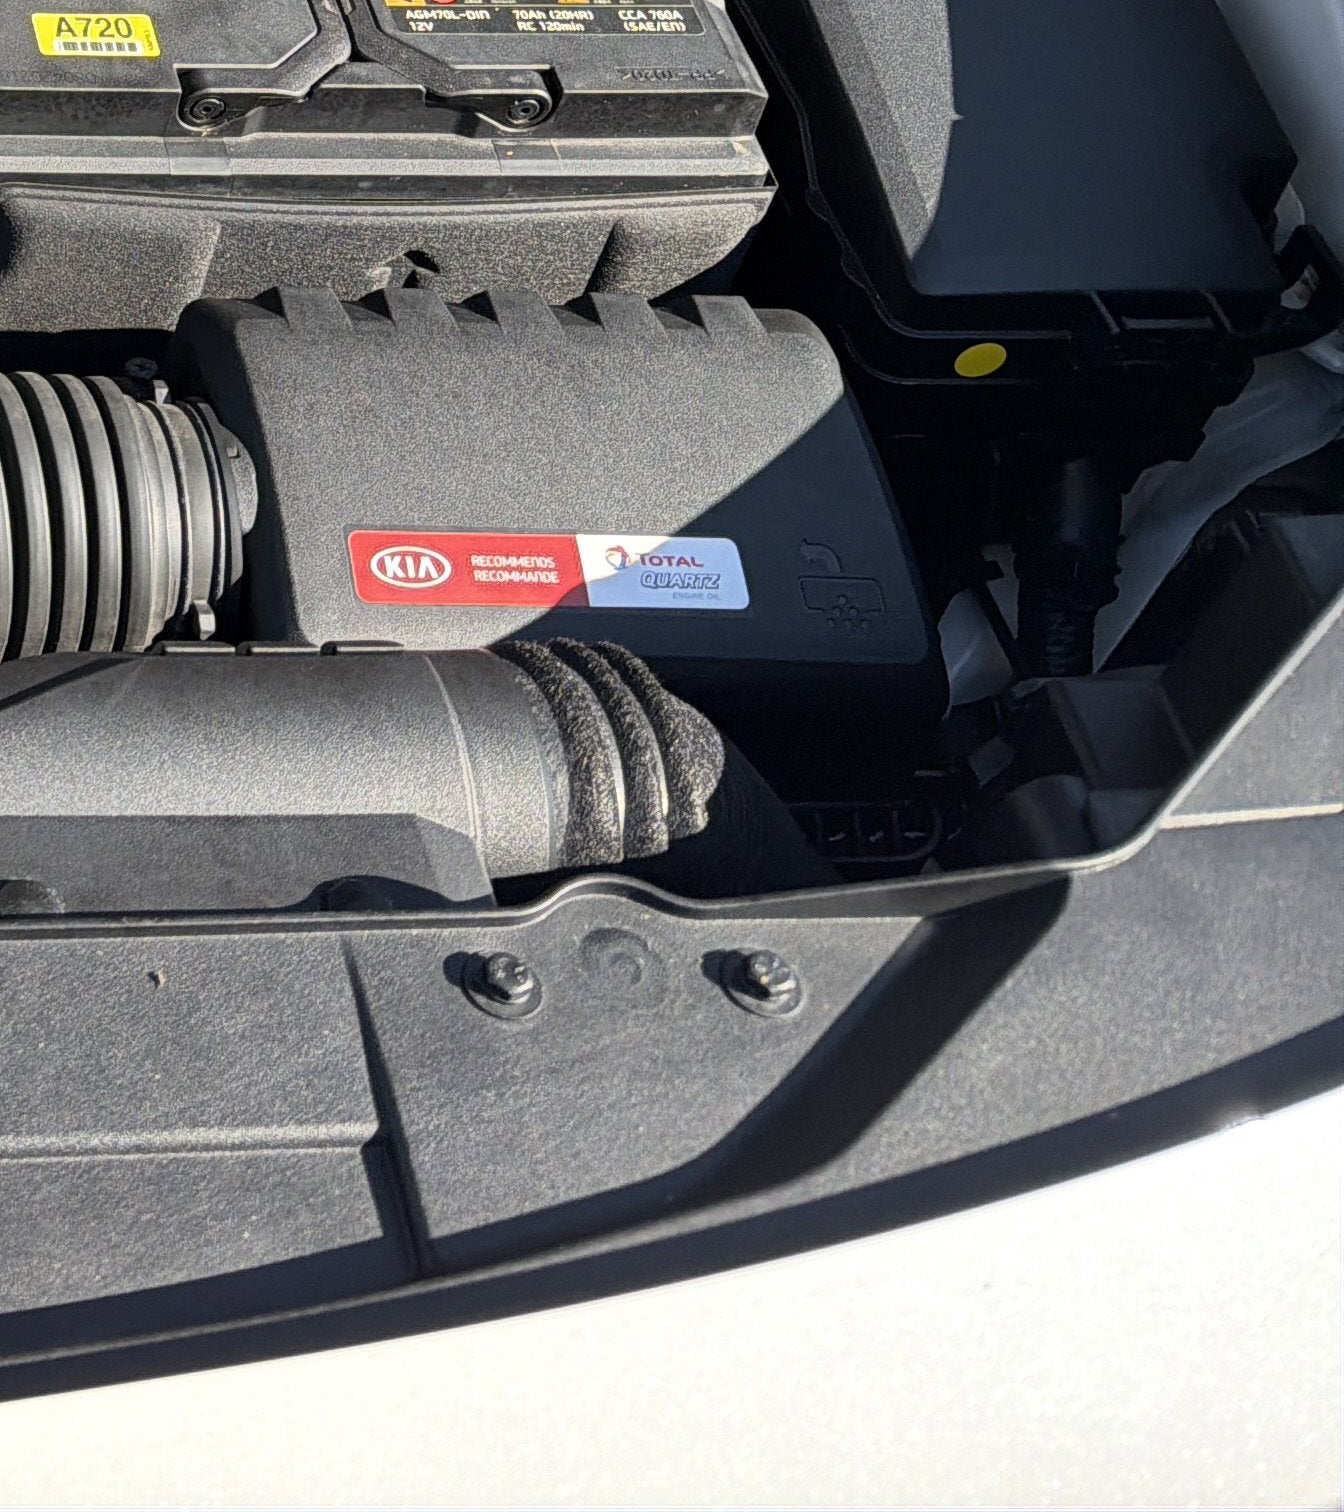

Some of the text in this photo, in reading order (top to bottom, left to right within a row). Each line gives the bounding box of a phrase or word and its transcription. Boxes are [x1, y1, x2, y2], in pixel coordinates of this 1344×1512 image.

[511, 9, 547, 20] 70Ah
[617, 9, 648, 20] CCA
[56, 17, 133, 39] A720
[409, 21, 434, 32] 12V
[517, 21, 537, 32] RC
[540, 21, 585, 32] 120min
[384, 554, 443, 580] KIA
[470, 554, 557, 569] RECOMMENDS
[635, 552, 704, 568] TOTAL
[473, 570, 560, 584] RECOMMANDE
[640, 571, 721, 590] QUARTZ
[671, 592, 705, 601] ENGINE
